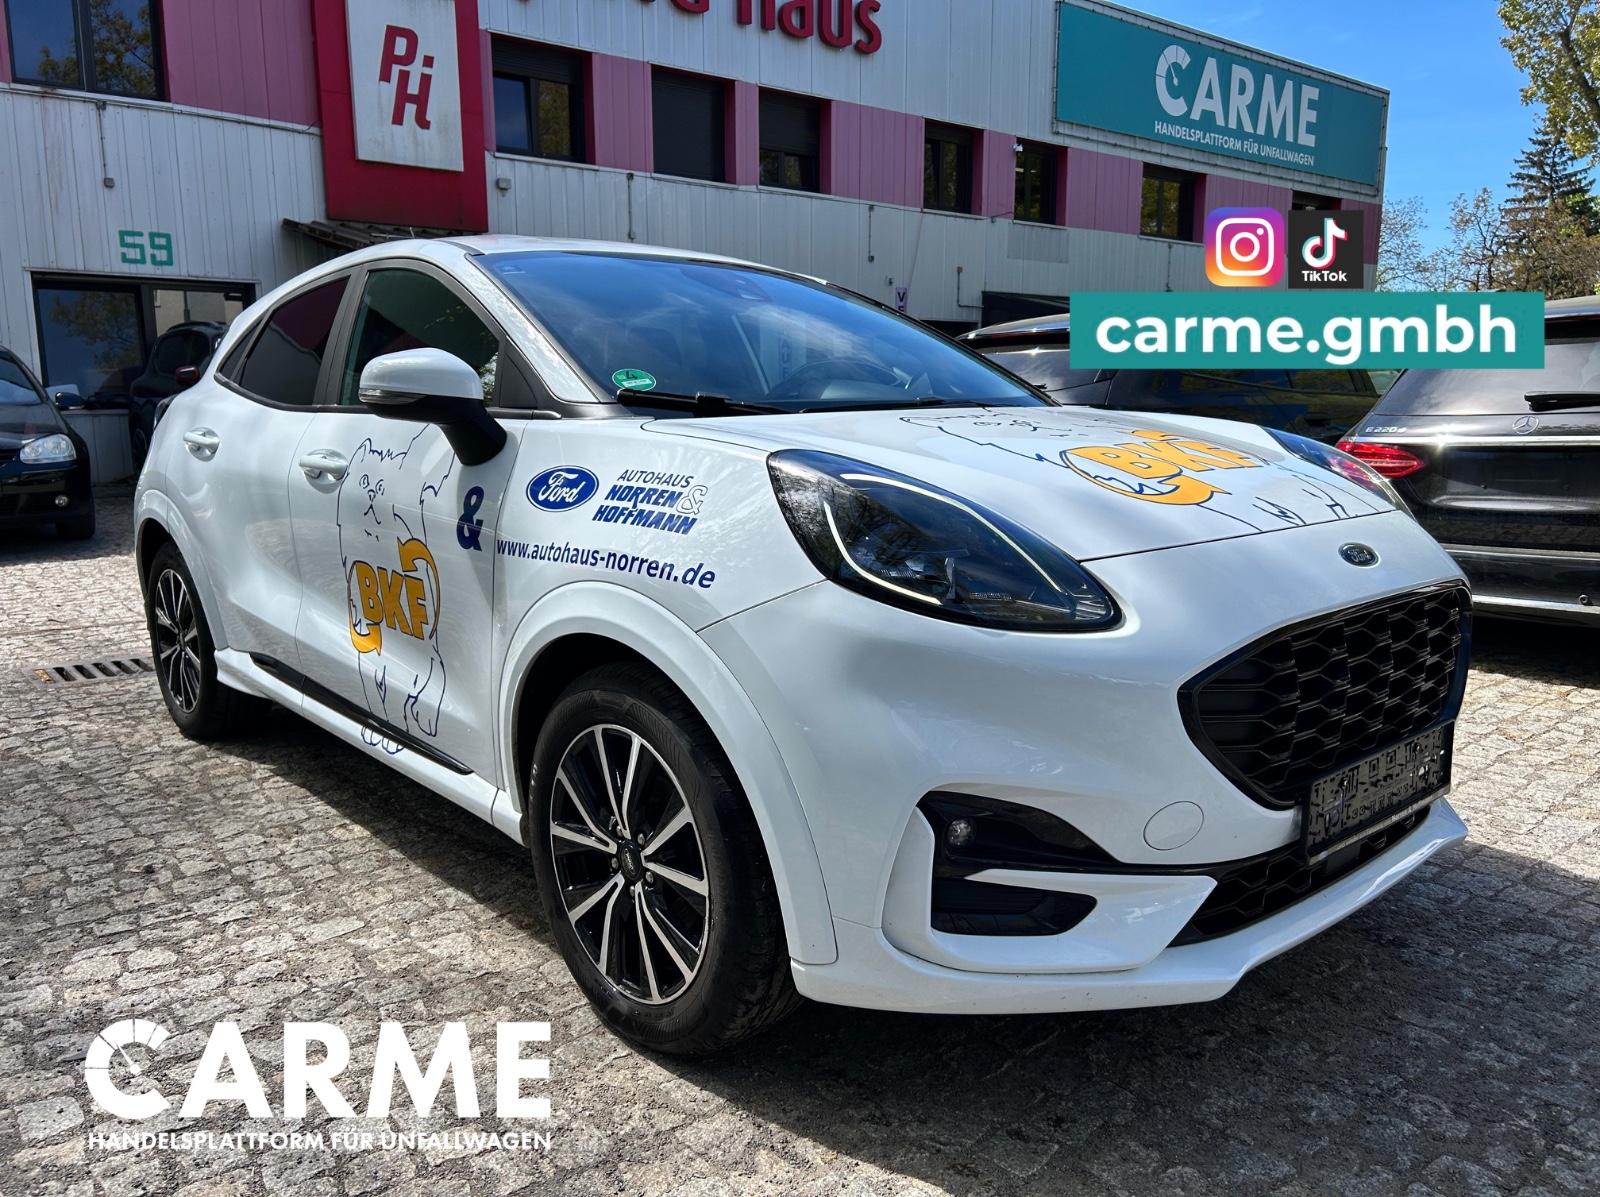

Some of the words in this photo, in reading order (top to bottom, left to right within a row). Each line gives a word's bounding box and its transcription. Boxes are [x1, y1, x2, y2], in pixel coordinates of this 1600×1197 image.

[1156, 45, 1319, 147] CARME
[1155, 121, 1242, 151] HANDELSPLATTFORM
[1243, 138, 1259, 156] FÜR
[1260, 144, 1314, 167] UNFALLWAGEN
[118, 229, 174, 267] 59
[617, 469, 695, 489] AUTOHAUS
[1064, 440, 1264, 480] BKF
[537, 470, 587, 503] Ford
[604, 484, 684, 509] NORREN
[676, 484, 708, 516] &
[457, 485, 484, 552] &
[592, 504, 698, 536] HOFFMANN
[496, 539, 716, 589] www.autohaus-norren.de
[353, 560, 430, 641] BKF
